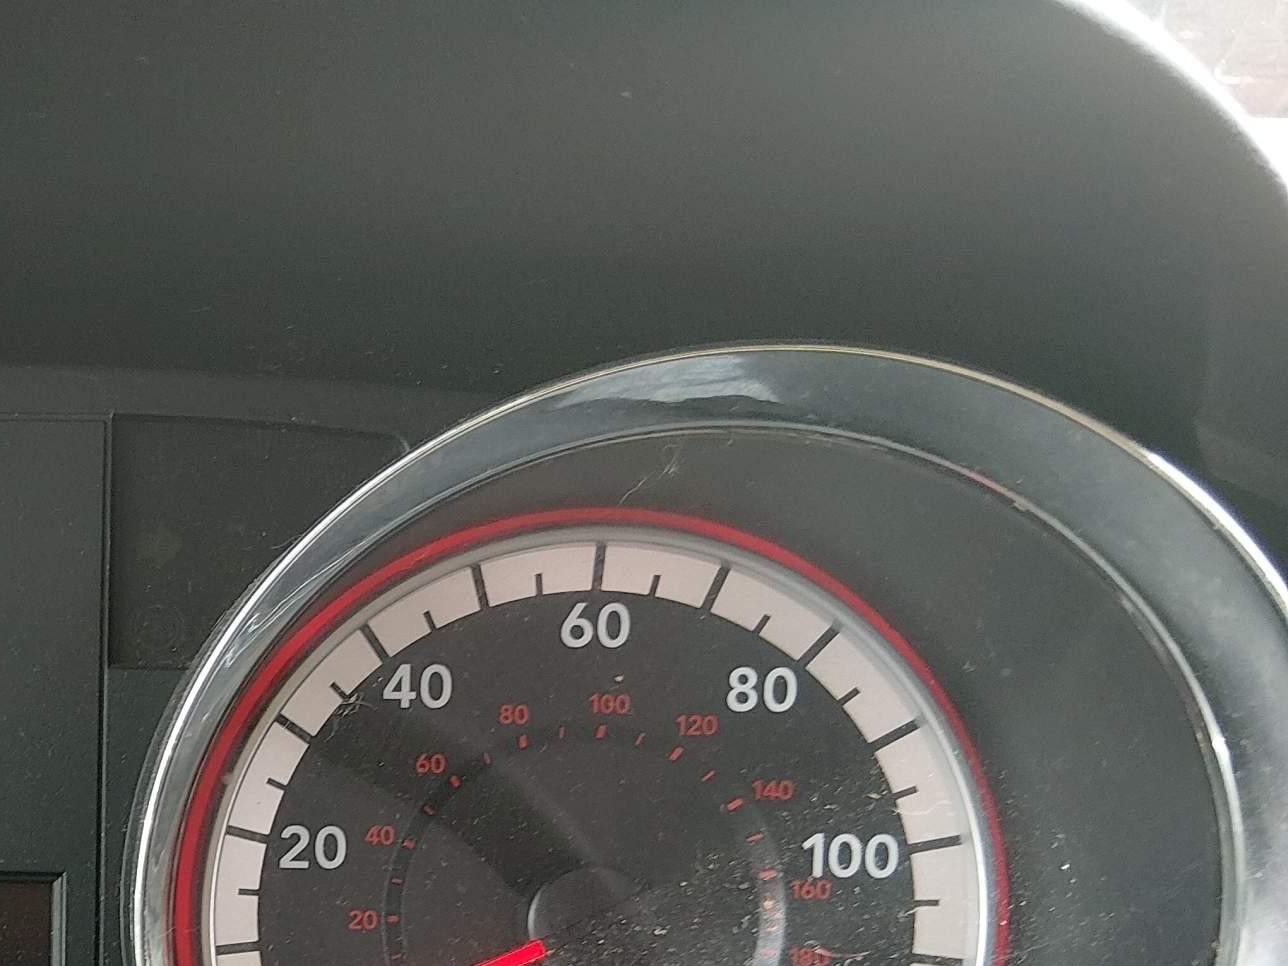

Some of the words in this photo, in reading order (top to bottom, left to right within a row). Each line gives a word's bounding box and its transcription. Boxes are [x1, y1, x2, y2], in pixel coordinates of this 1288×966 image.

[560, 602, 631, 649] 60
[382, 663, 453, 710] 40
[726, 666, 798, 713] 80
[499, 704, 530, 725] 80
[589, 693, 631, 715] 100
[675, 714, 719, 736] 120
[415, 753, 446, 774] 60
[752, 779, 793, 800] 140
[364, 825, 395, 846] 40
[278, 825, 348, 871] 20
[801, 833, 899, 879] 100
[791, 879, 832, 900] 160
[348, 910, 378, 930] 20
